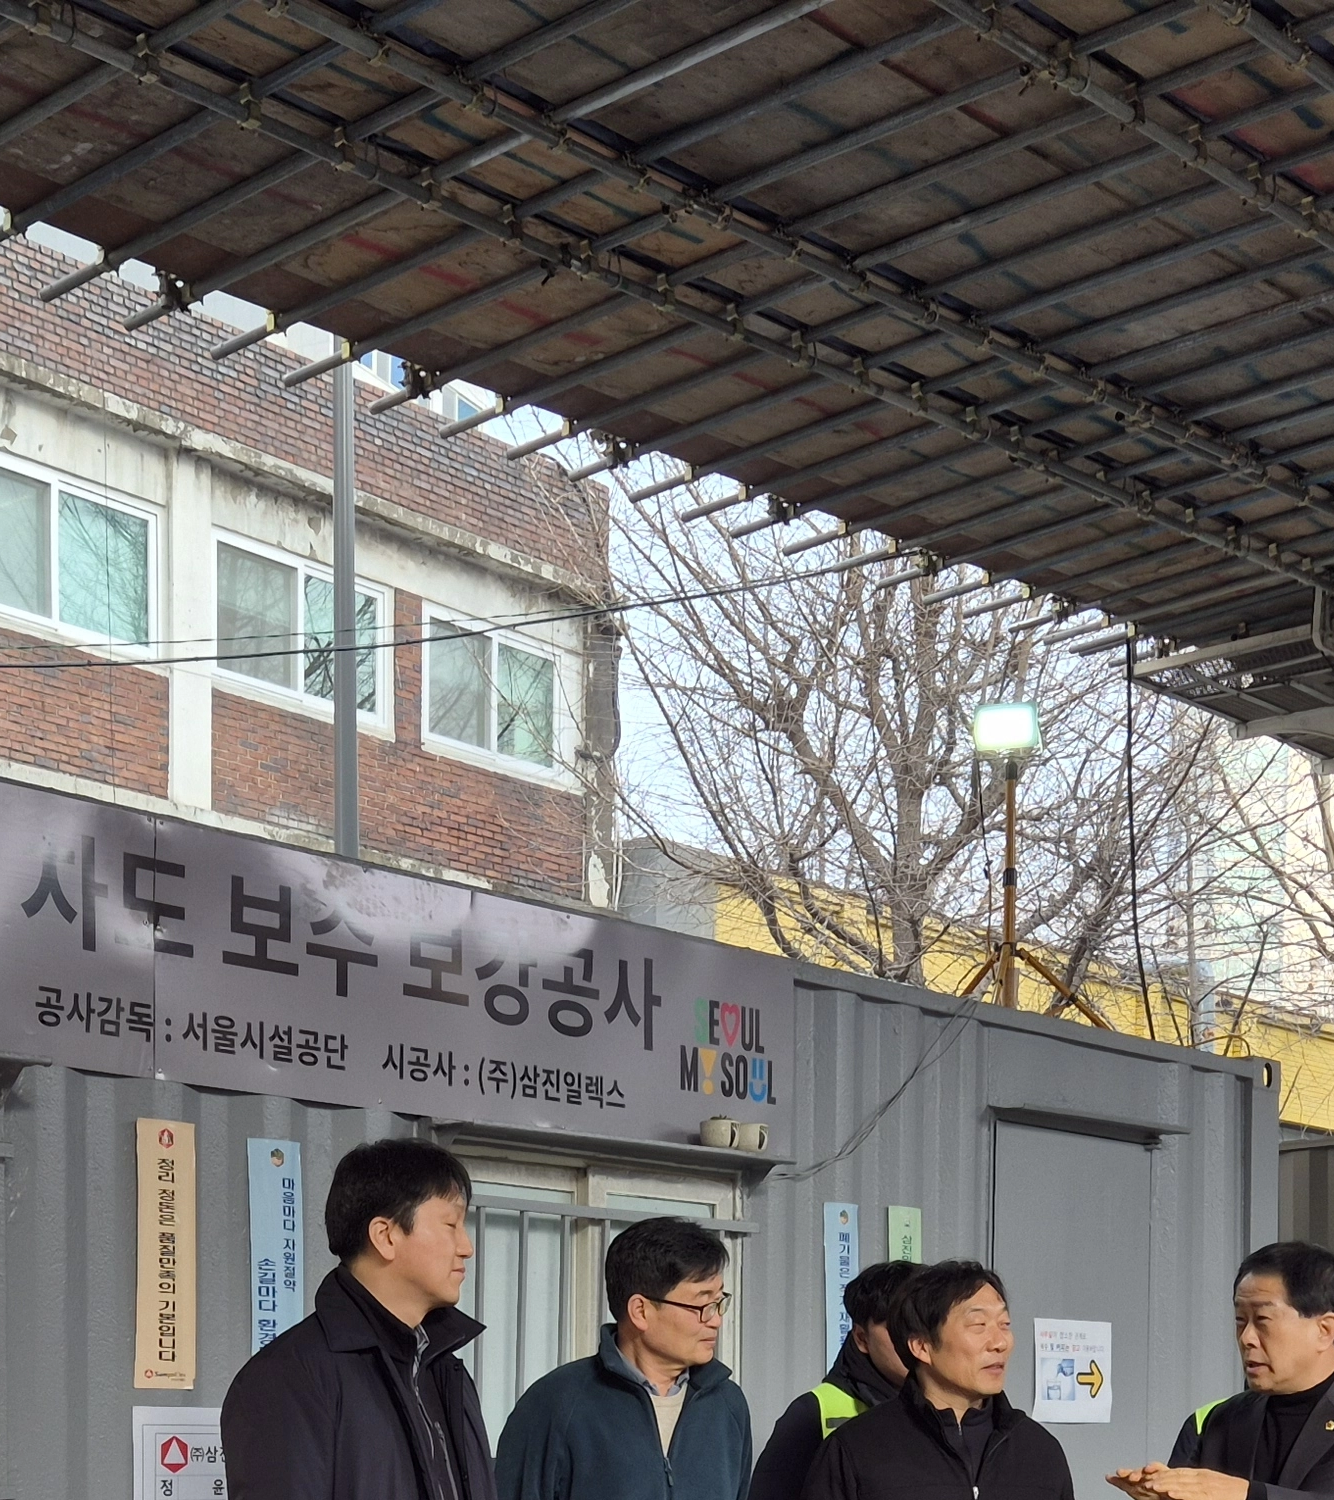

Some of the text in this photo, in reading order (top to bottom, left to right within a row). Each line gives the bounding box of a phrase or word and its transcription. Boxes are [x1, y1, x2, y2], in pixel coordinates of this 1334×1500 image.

[222, 875, 378, 997] 보수
[403, 924, 662, 1052] 보강공사
[35, 986, 155, 1042] 공사감독
[182, 1011, 348, 1071] 서울시설공단
[381, 1043, 456, 1087] 시공사
[478, 1055, 627, 1110] (주)삼진일렉스
[157, 1158, 177, 1362] 정리 정돈은 품질만족의 기본입니다
[282, 1178, 297, 1292] 마음마다 자원절약
[838, 1232, 850, 1279] 폐기물은
[257, 1258, 278, 1350] 손길마다 환경
[160, 1479, 173, 1497] 정
